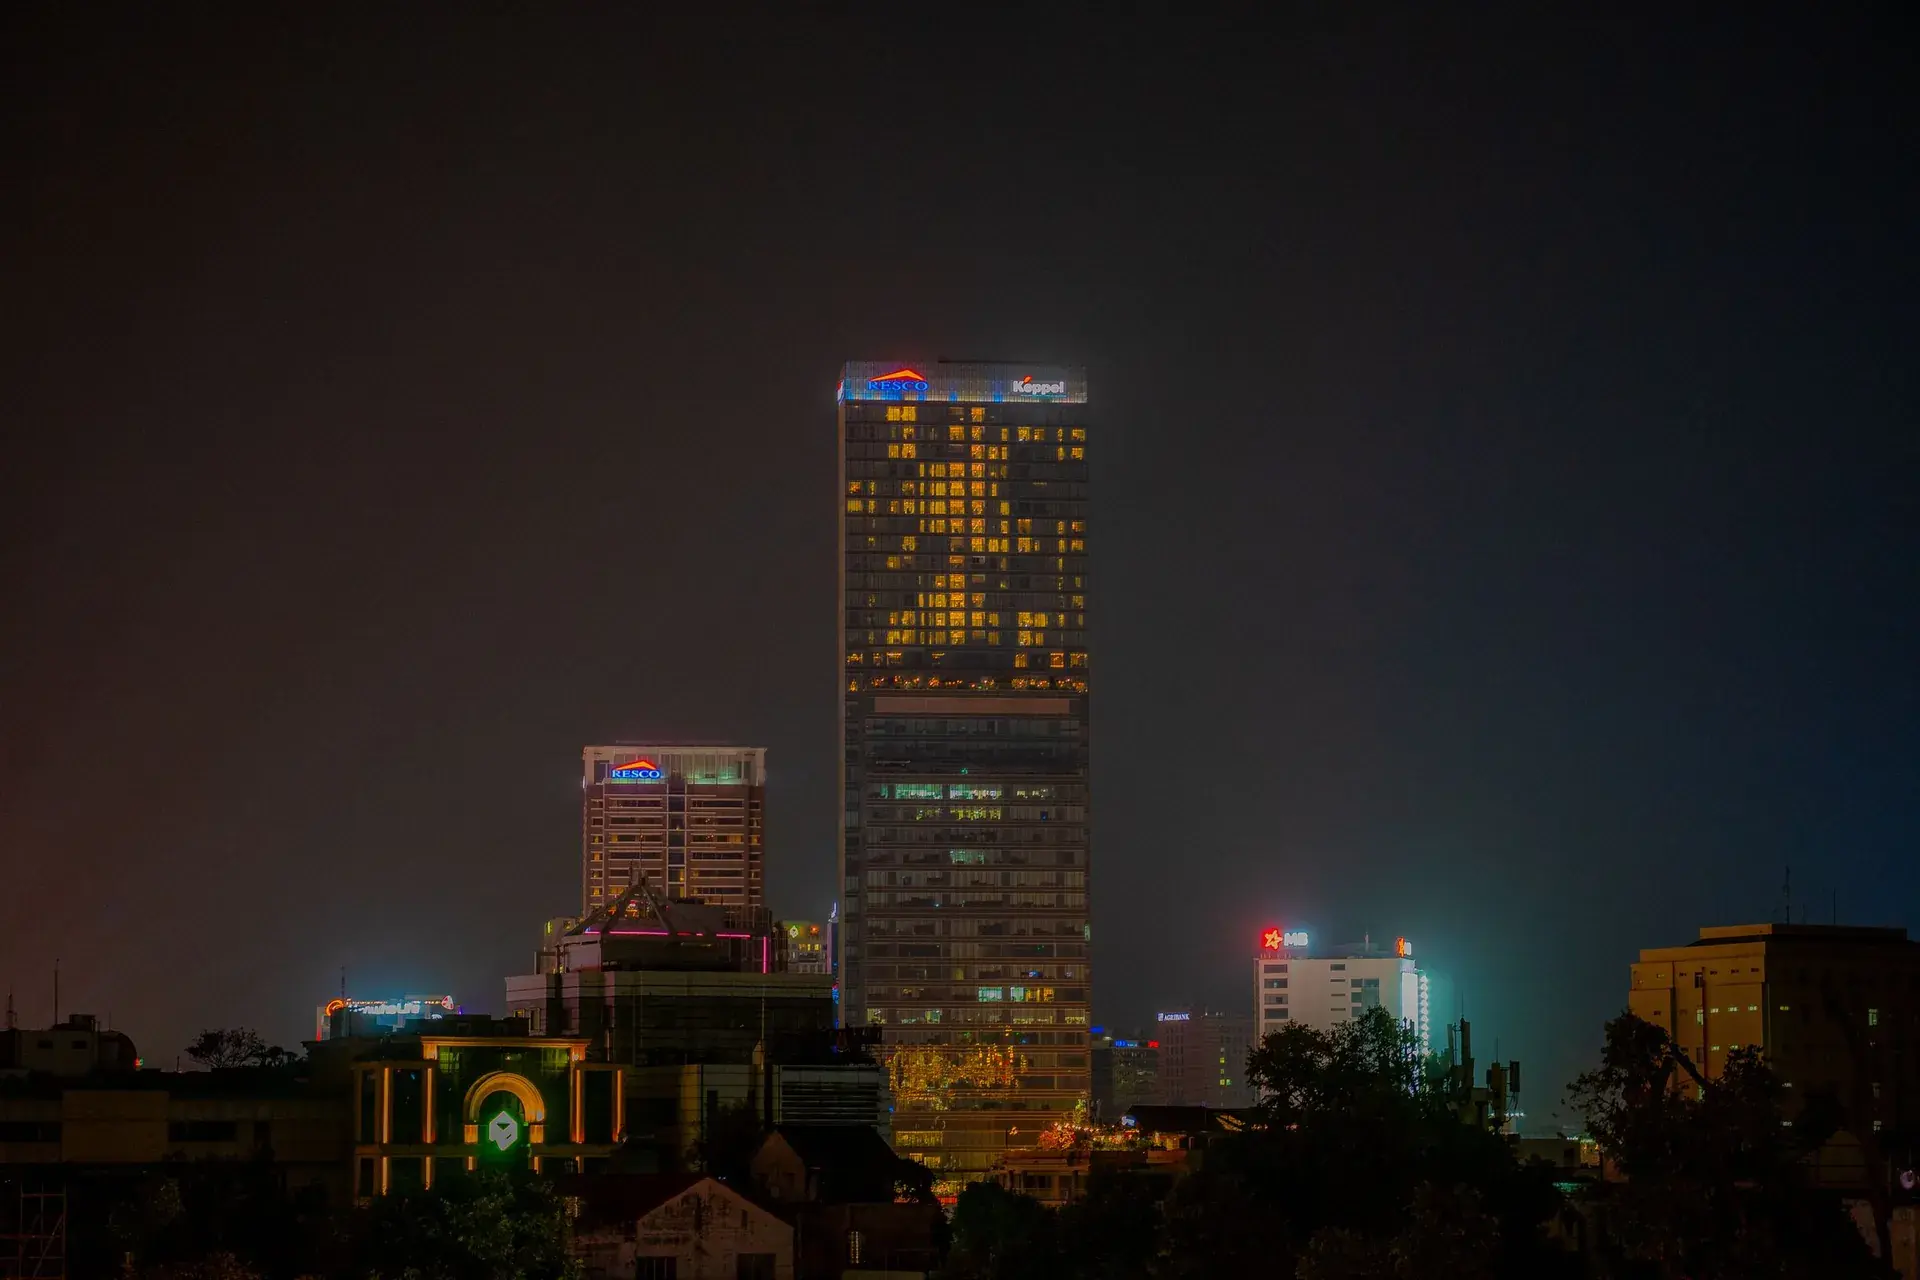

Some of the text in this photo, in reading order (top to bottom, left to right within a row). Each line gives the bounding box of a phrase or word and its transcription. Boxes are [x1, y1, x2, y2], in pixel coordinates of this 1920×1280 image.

[868, 381, 928, 391] RESCO
[1013, 380, 1064, 395] Keppel
[612, 769, 660, 779] RESCO
[1284, 933, 1309, 947] MB
